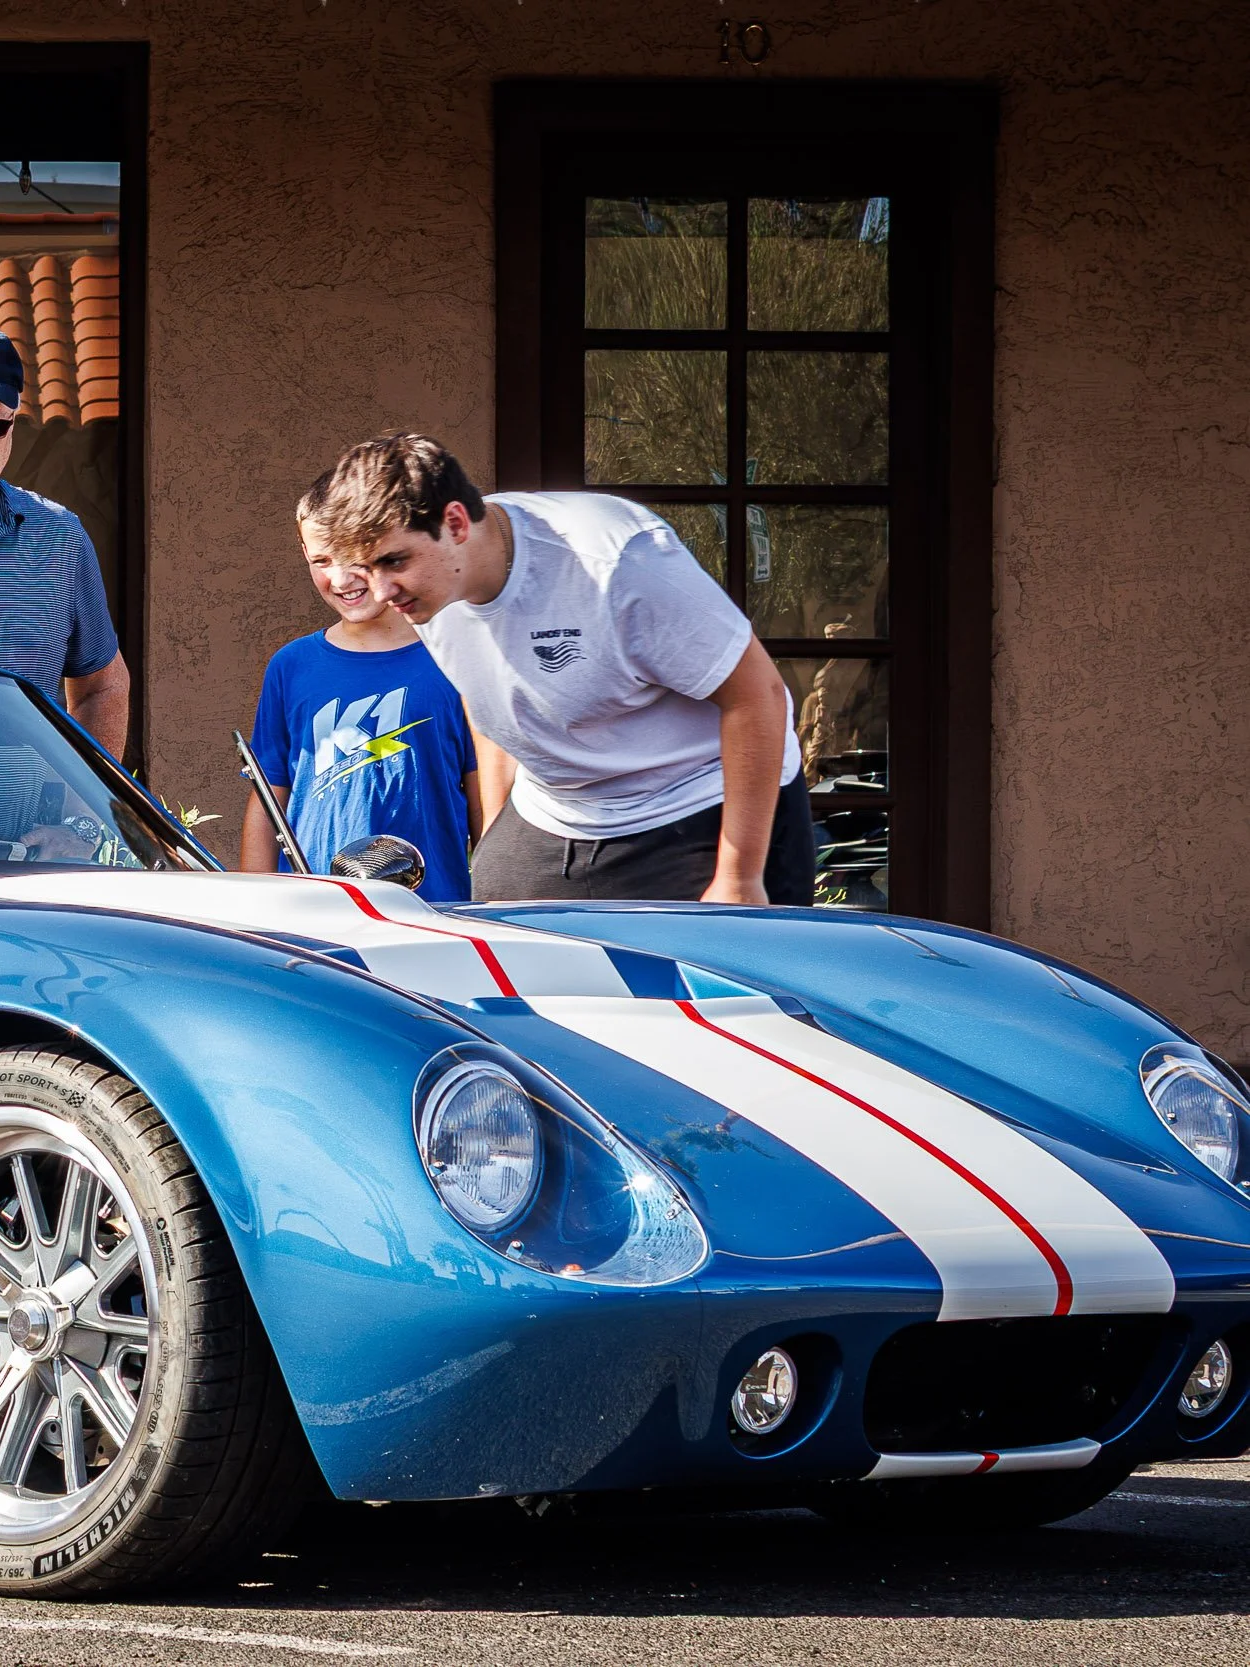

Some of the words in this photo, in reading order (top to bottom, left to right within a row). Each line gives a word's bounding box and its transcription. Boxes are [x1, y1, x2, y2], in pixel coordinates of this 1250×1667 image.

[717, 21, 771, 66] 10
[312, 686, 409, 777] K1
[317, 755, 400, 801] RACNG
[16, 1073, 53, 1090] SPORT
[40, 1484, 137, 1574] MICHELIN
